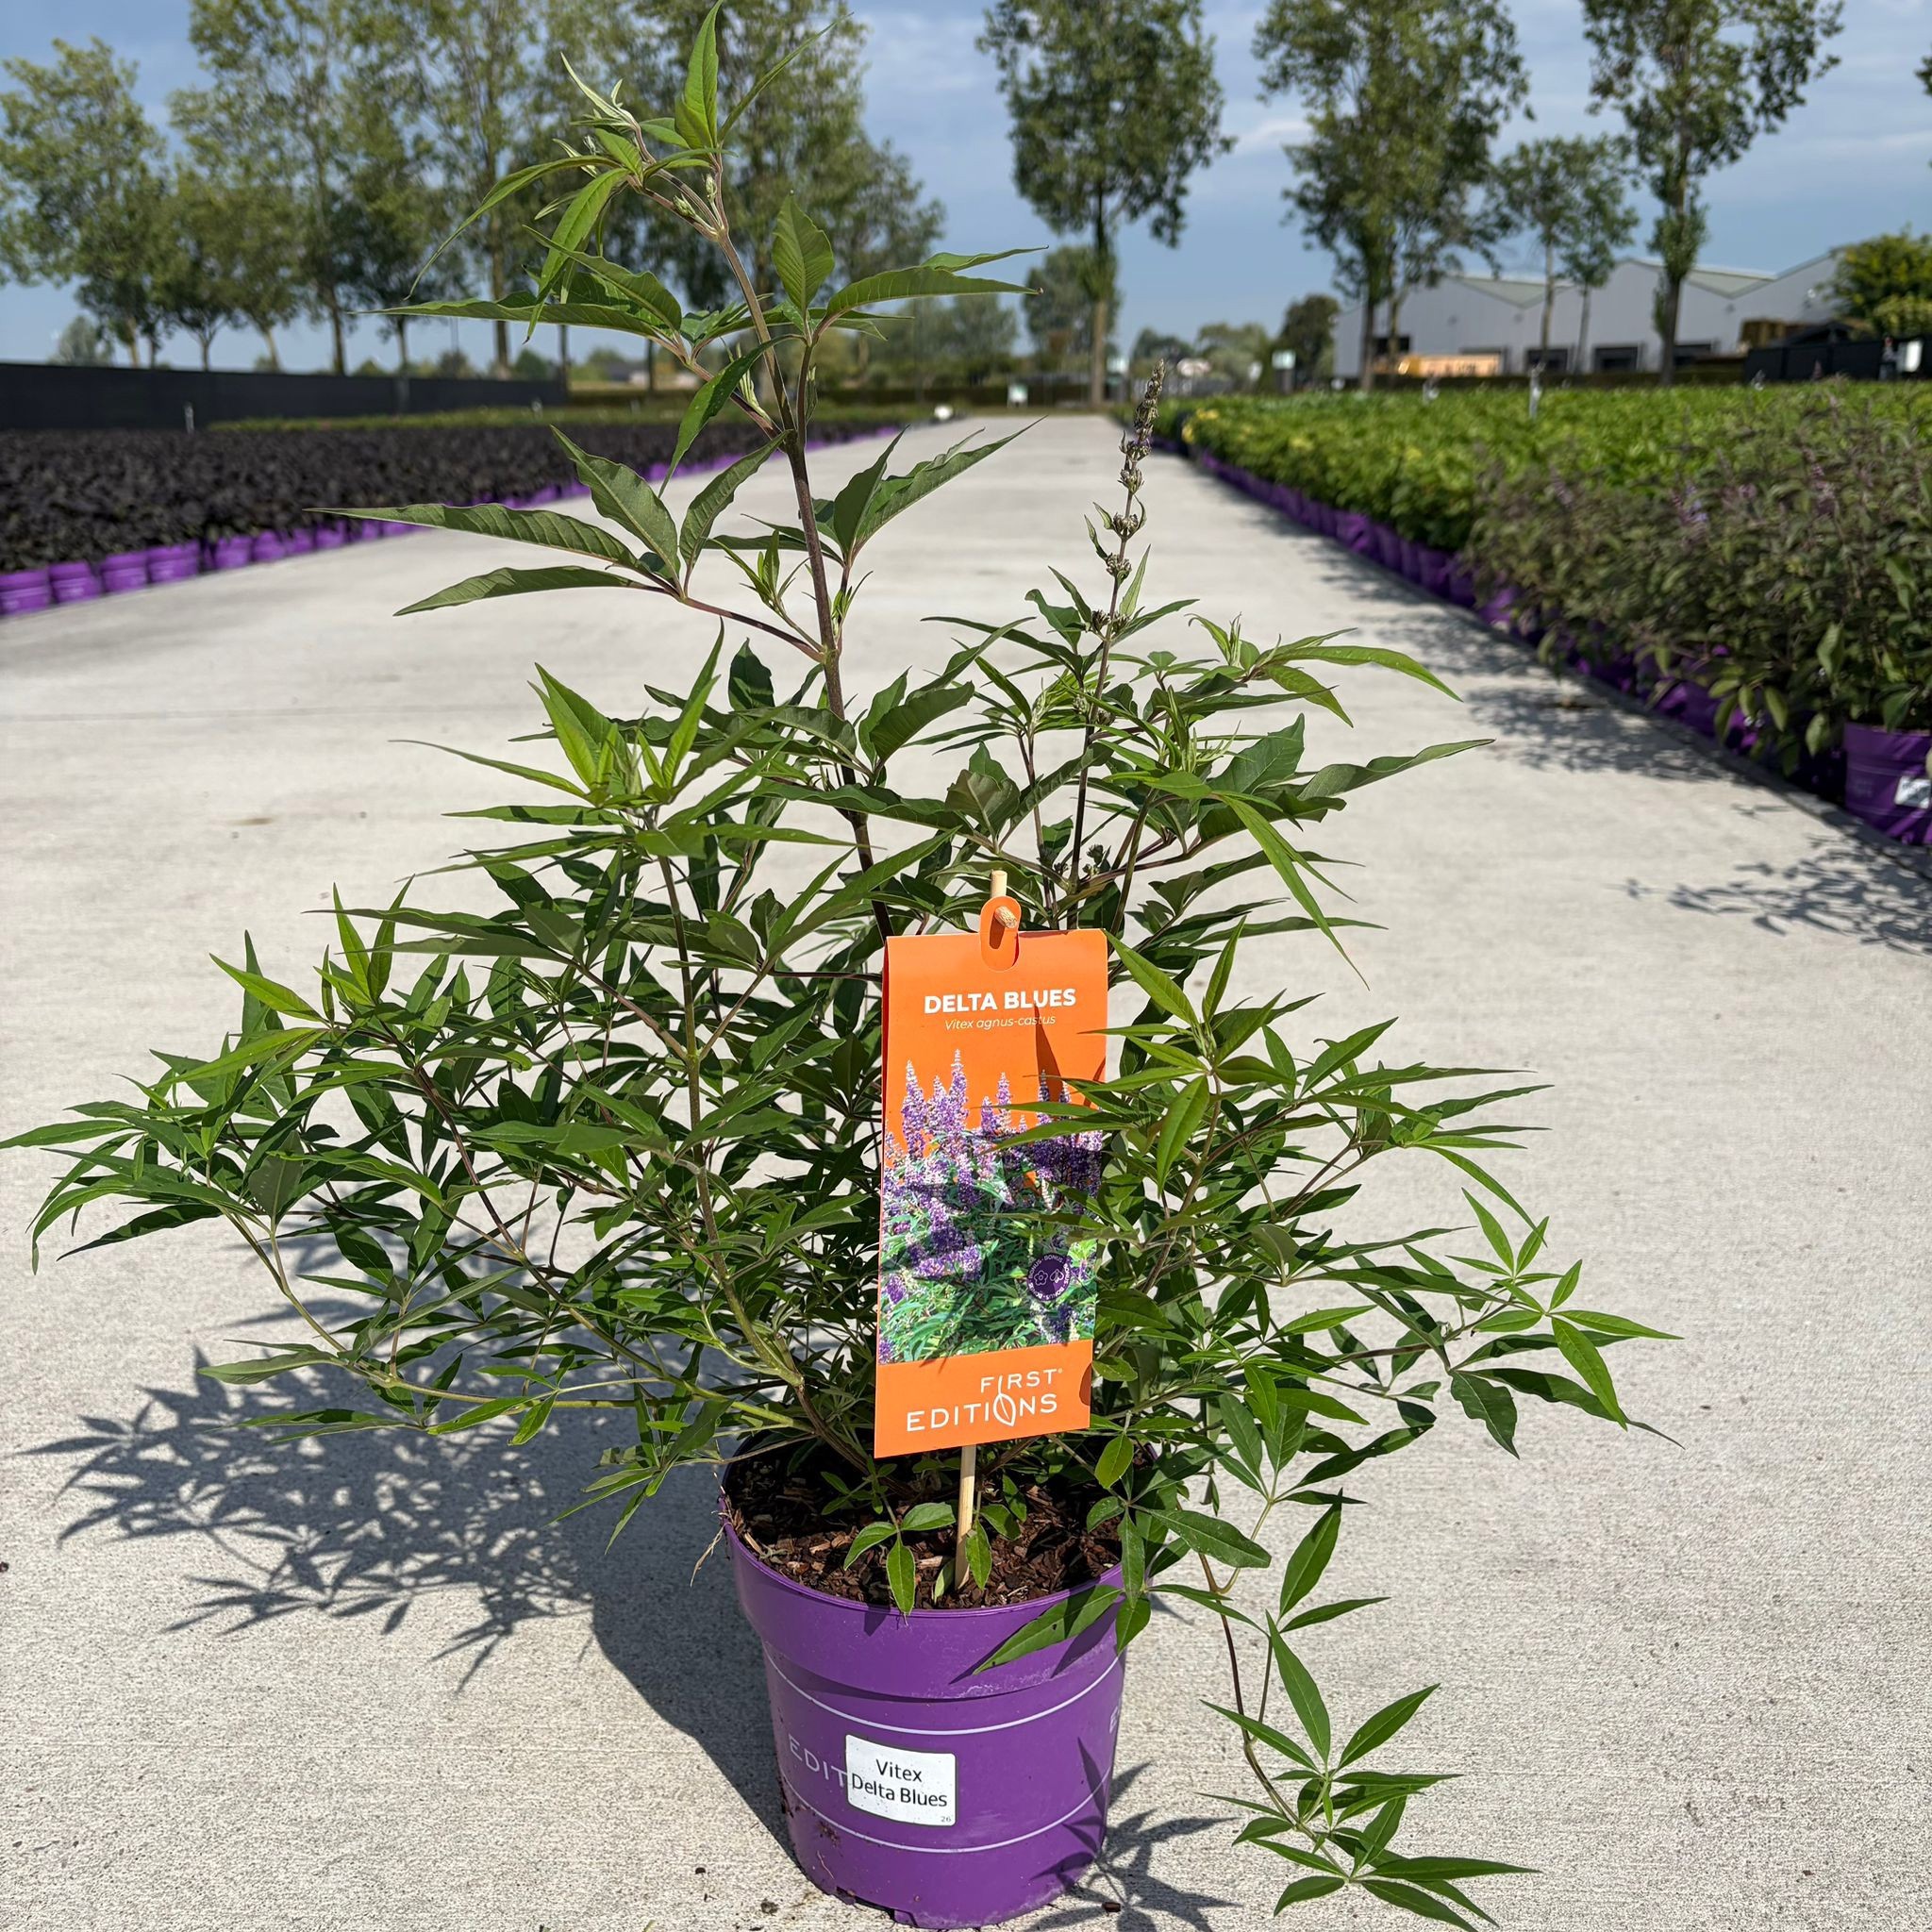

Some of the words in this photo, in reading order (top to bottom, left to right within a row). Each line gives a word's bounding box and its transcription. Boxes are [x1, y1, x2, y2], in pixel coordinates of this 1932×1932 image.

[924, 991, 997, 1014] DELTA
[1004, 988, 1076, 1009] BLUES
[945, 1018, 974, 1030] Vitex
[976, 1014, 1056, 1031] agnus-castus
[1043, 1255, 1063, 1263] BONUS
[980, 1368, 1057, 1393] FIRST
[907, 1392, 1058, 1432] EDITIONS
[788, 1733, 848, 1788] EDIT
[875, 1758, 923, 1782] Vitex
[852, 1773, 895, 1801] Delta
[900, 1788, 948, 1807] Blues
